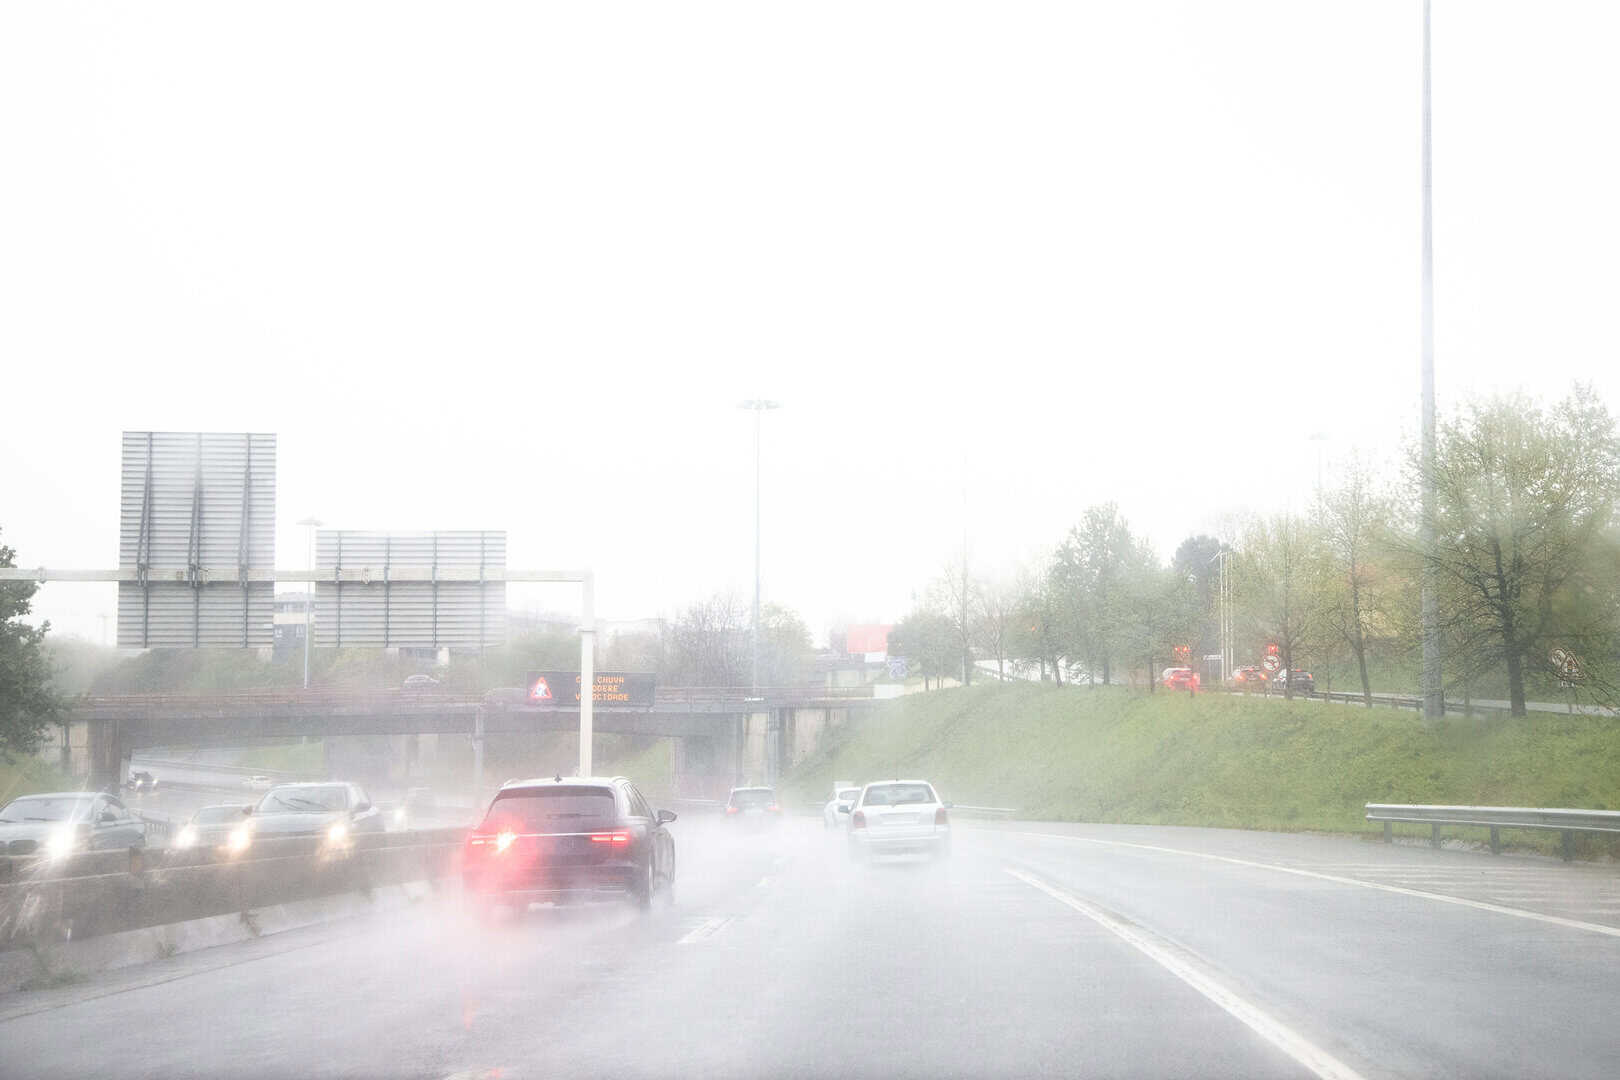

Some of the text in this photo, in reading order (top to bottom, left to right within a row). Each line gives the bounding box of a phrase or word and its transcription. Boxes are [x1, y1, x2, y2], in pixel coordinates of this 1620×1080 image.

[597, 675, 625, 684] CHUVA
[588, 684, 619, 693] ODERE
[575, 692, 630, 701] VOCIDADE
